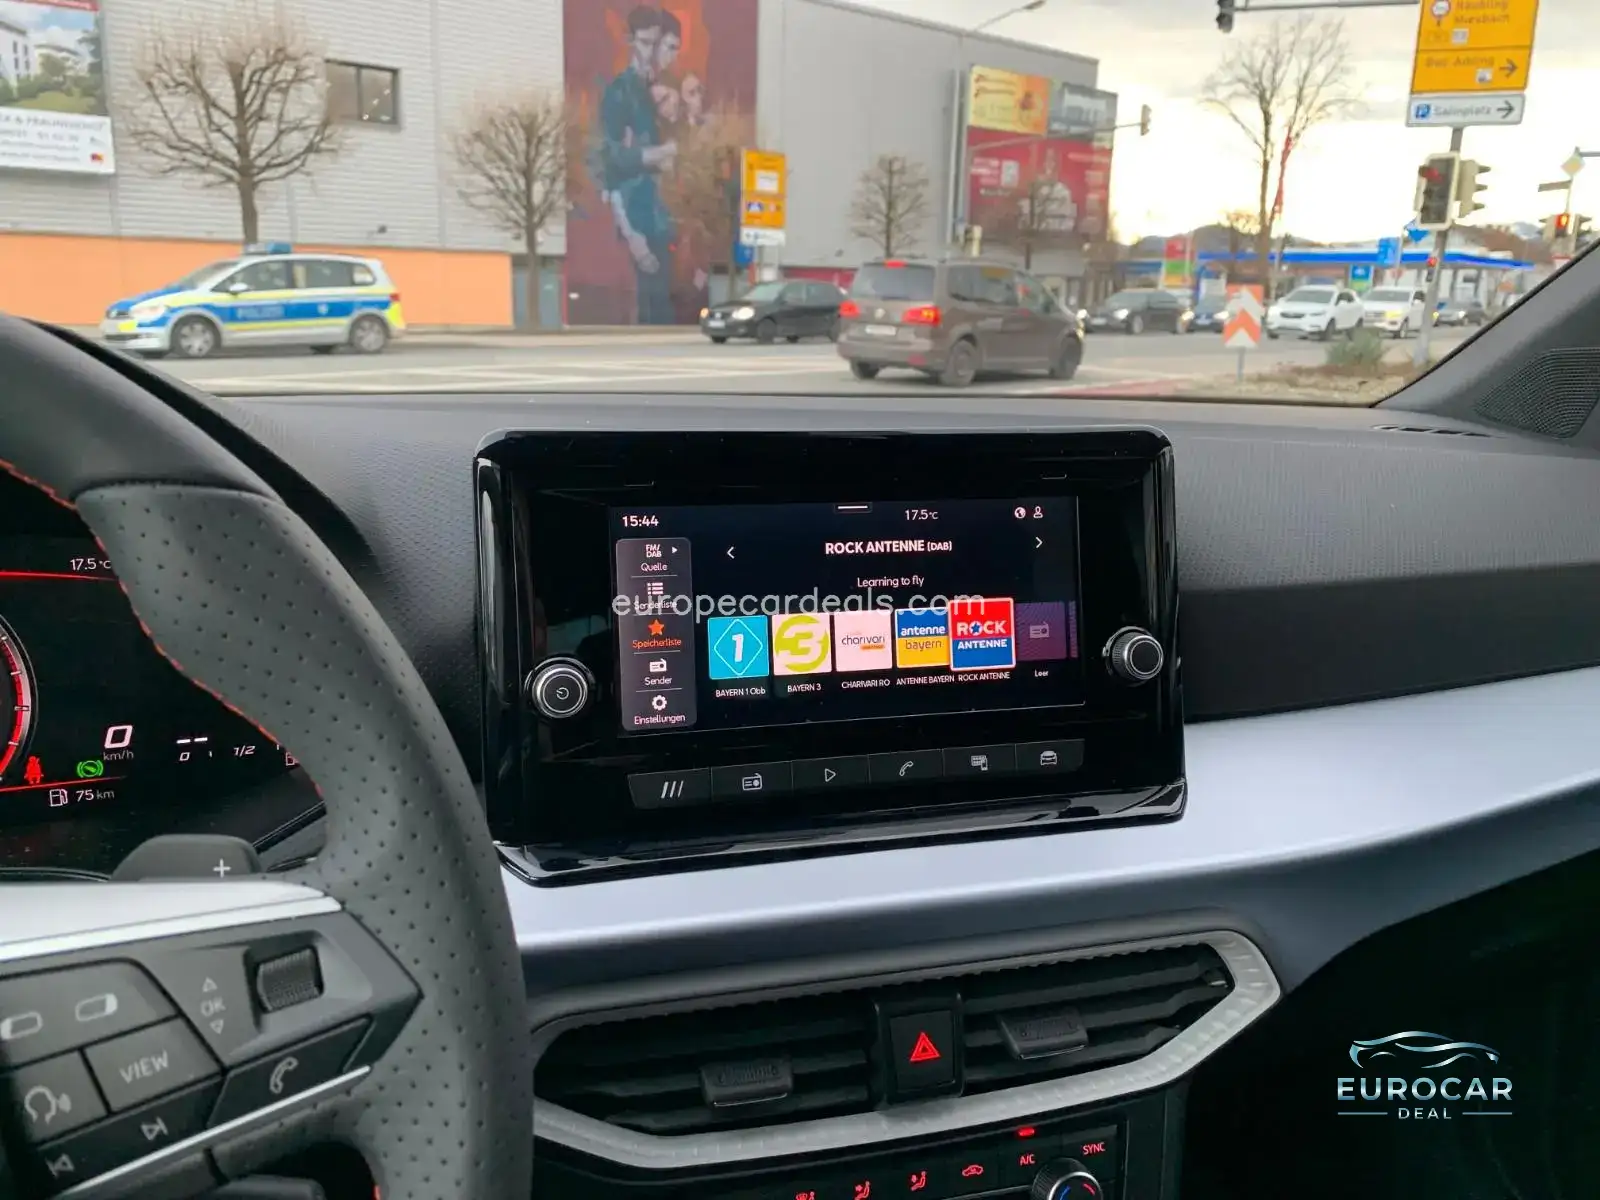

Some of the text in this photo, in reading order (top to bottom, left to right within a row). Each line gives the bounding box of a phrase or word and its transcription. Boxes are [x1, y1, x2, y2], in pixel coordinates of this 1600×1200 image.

[622, 515, 659, 528] 15:44
[824, 540, 953, 555] ROCK ANTENNE (DAB)
[640, 562, 668, 572] Quelle
[857, 575, 925, 589] Learning to fly
[900, 625, 946, 637] antenne
[956, 620, 1007, 636] ROCK
[632, 638, 682, 649] Speicherliste
[841, 634, 886, 646] charivari
[905, 638, 942, 652] bayern
[957, 639, 1008, 650] ANTENNE
[731, 633, 744, 663] 1
[958, 672, 1011, 682] ROCK ANTENNE
[1034, 669, 1049, 677] Leer
[644, 676, 673, 686] Sender
[841, 678, 891, 689] CHARIVARI RO
[896, 675, 955, 686] ANTENNE BAYERN
[715, 688, 745, 698] BAYERN
[787, 683, 822, 693] BAYERN 3
[634, 713, 686, 726] Einstellungen
[103, 750, 134, 761] km/h
[233, 745, 256, 757] 1/2
[76, 788, 115, 802] 75 km
[201, 997, 226, 1016] OK
[119, 1051, 170, 1084] VIEW
[1083, 1142, 1106, 1156] SYNC
[1020, 1154, 1035, 1166] A/C
